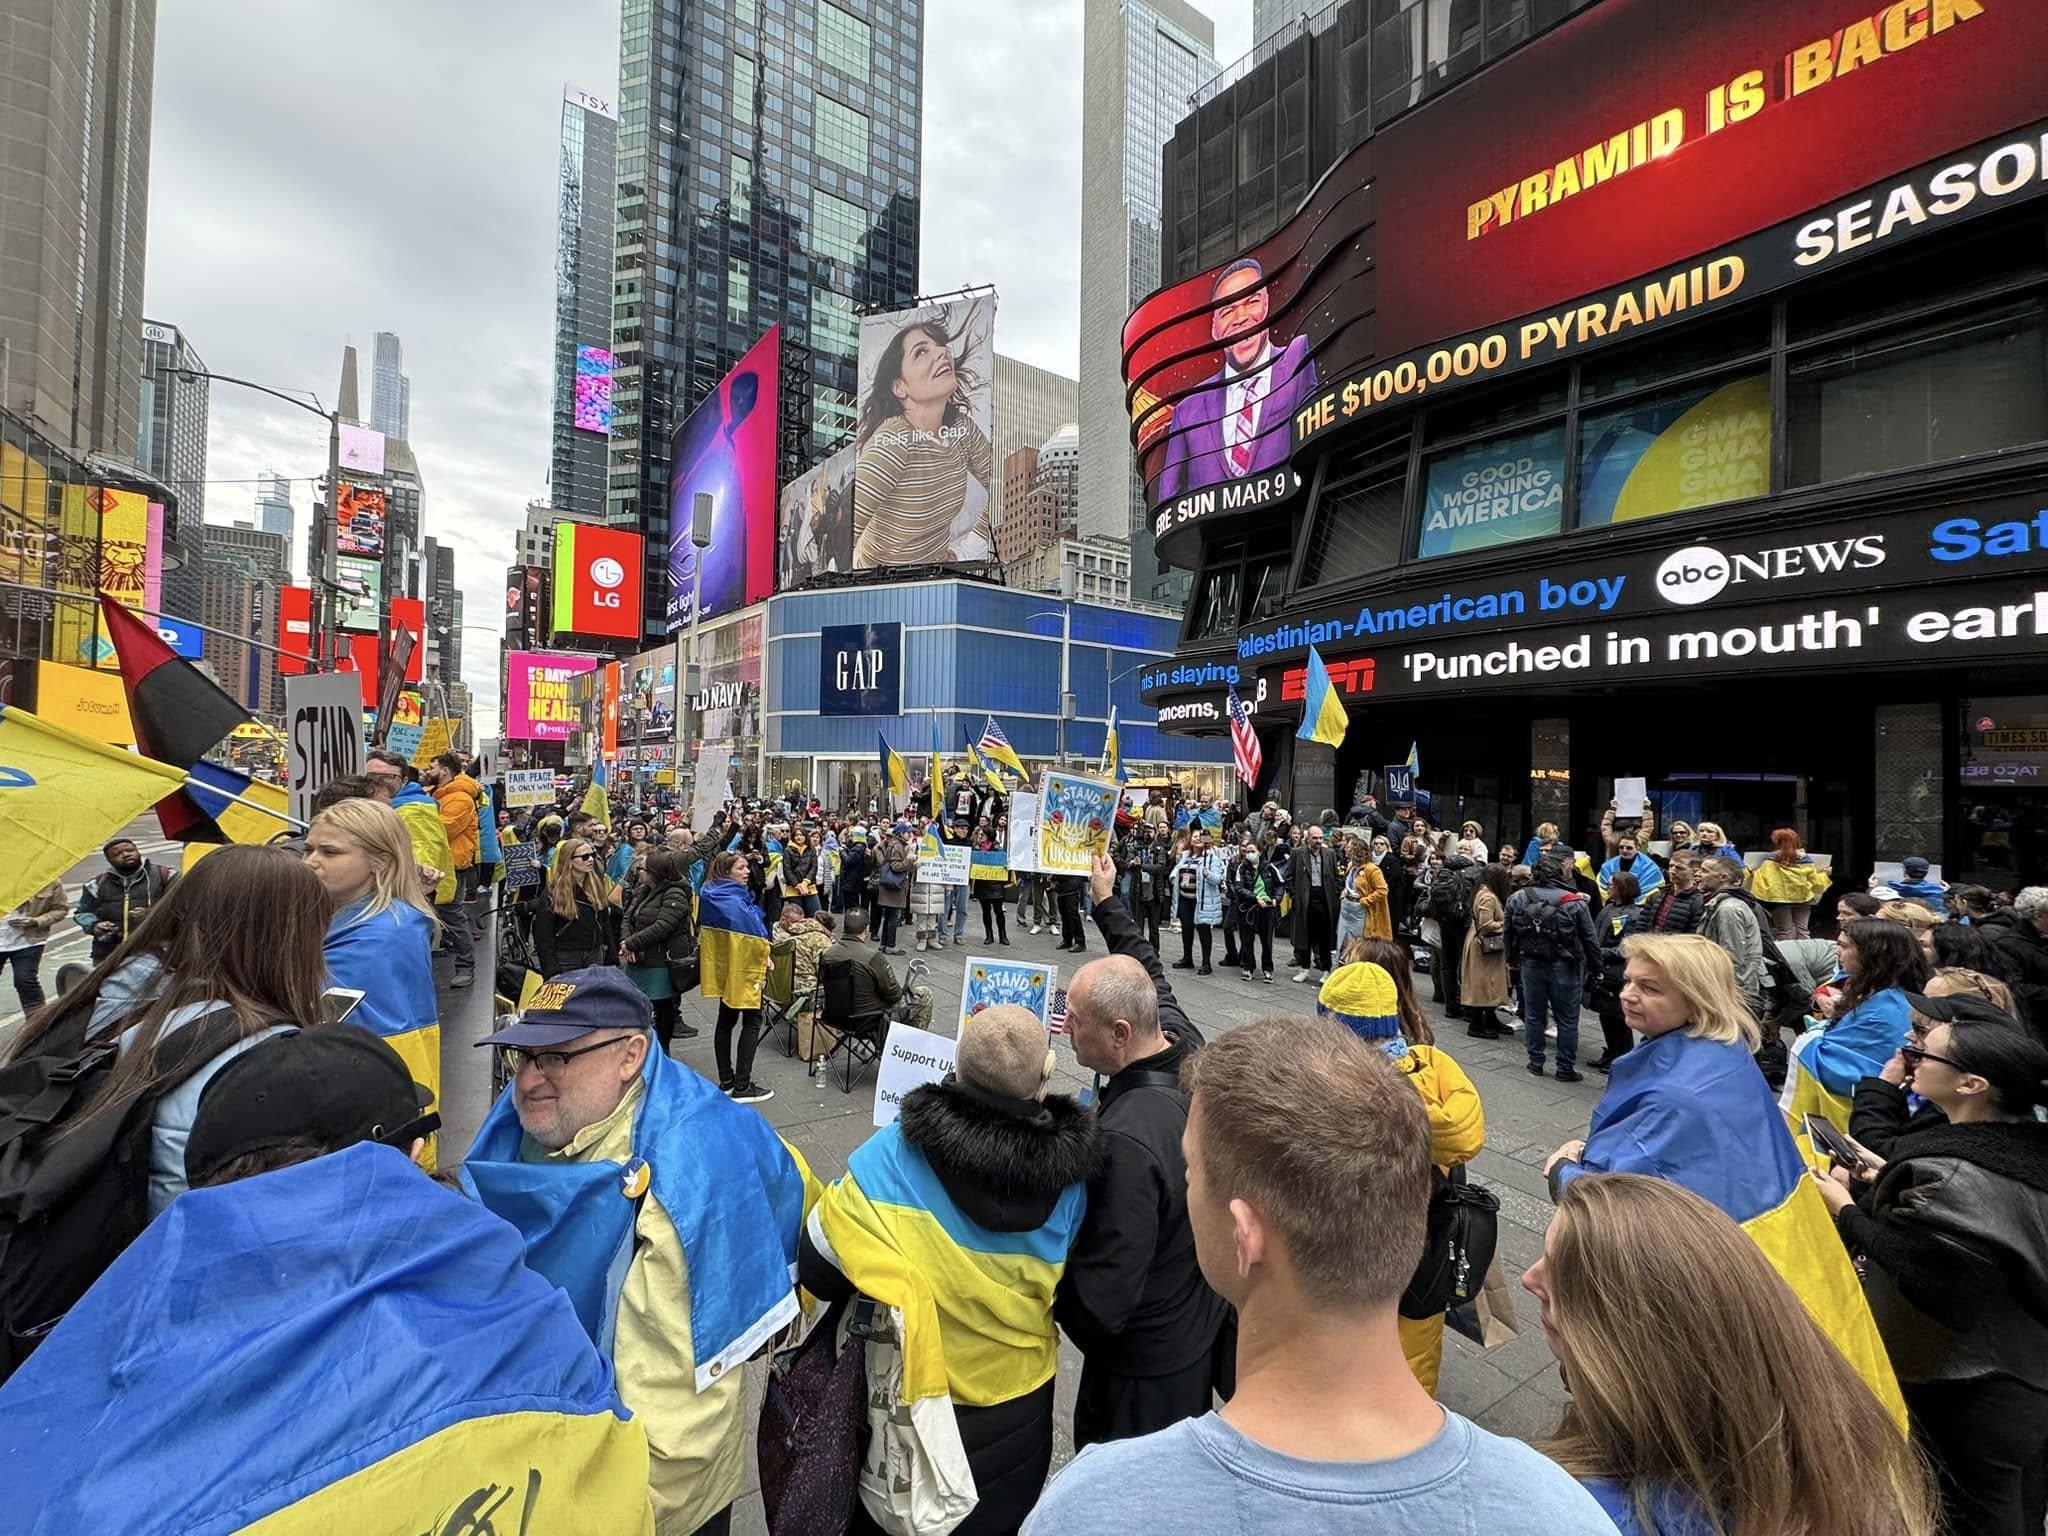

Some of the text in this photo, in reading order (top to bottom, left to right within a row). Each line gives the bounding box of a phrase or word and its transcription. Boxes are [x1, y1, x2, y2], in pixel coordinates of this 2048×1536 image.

[578, 91, 609, 113] TSX
[1466, 0, 1985, 241] PYRAMID IS BACK
[1296, 254, 1746, 442] THE $100,000 PYRAMID
[874, 425, 970, 447] Feels like Gap.
[1680, 410, 1763, 447] GMA
[1680, 435, 1763, 471] GMA
[1443, 469, 1553, 508] MORNING
[1461, 457, 1534, 488] GOOD
[1680, 459, 1763, 495] GMA
[1177, 490, 1215, 523] SUN
[1222, 483, 1271, 510] MAR
[1274, 472, 1286, 496] 9
[1426, 482, 1564, 532] AMERICA
[1662, 560, 1725, 587] abc
[1729, 534, 1888, 584] NEWS
[592, 590, 621, 609] LG
[1237, 575, 1627, 663] Palestinian-American boy
[1403, 634, 1591, 682] 'Punched
[1607, 631, 1651, 666] in
[1668, 606, 1880, 660] mouth'
[836, 649, 883, 691] GAP
[1156, 669, 1168, 688] in
[1171, 662, 1240, 686] slaying
[711, 682, 744, 709] NAVY
[295, 706, 357, 791] STAND
[1987, 731, 2026, 744] TIMES
[509, 772, 553, 783] FAIR PEACE
[509, 784, 516, 793] IS
[518, 784, 536, 792] ONLY
[1063, 786, 1101, 805] STAND
[987, 971, 1030, 992] STAND
[891, 1044, 936, 1068] Support
